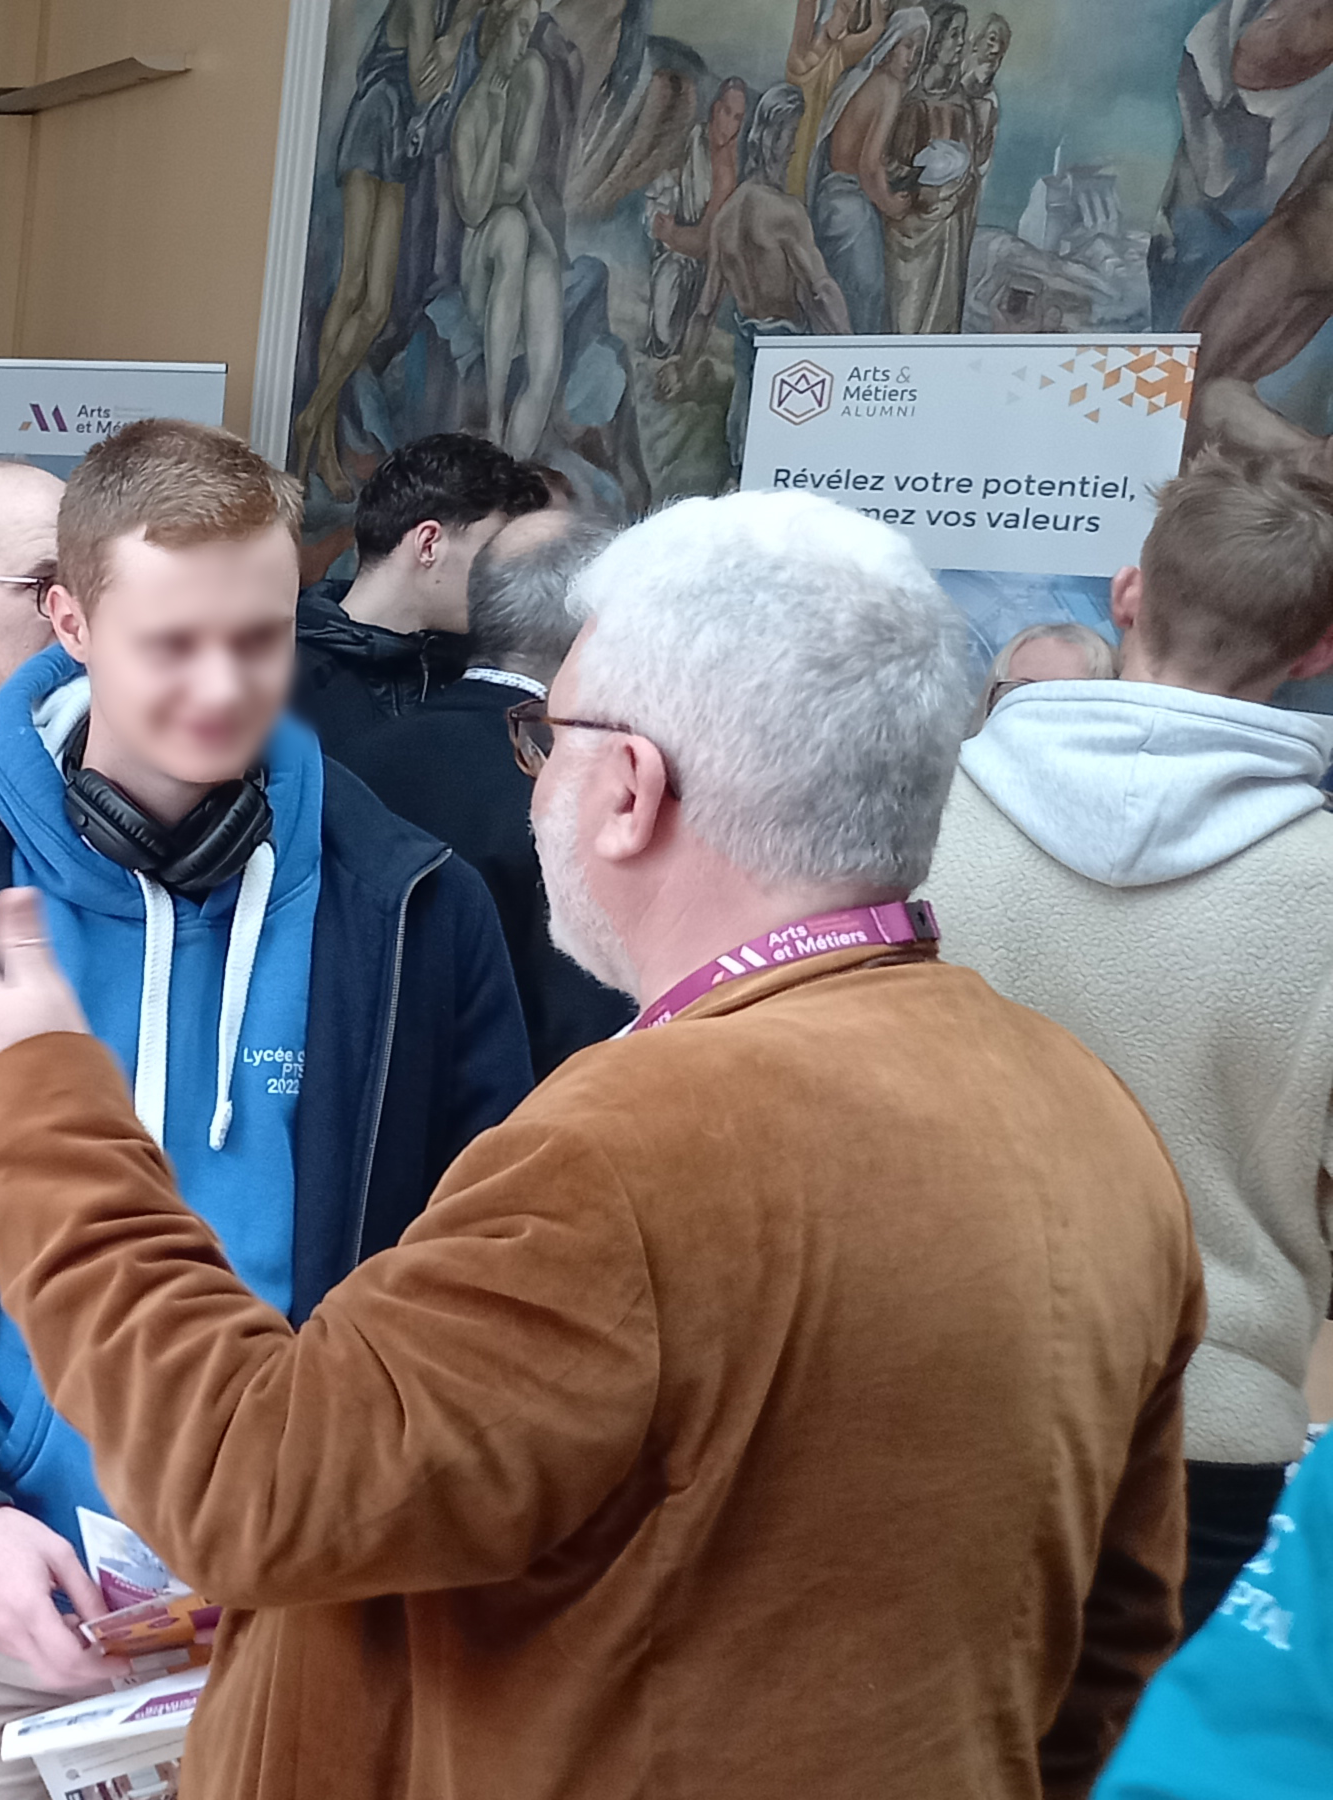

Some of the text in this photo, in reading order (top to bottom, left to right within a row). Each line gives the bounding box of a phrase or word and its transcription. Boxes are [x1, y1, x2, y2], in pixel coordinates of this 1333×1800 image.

[847, 366, 911, 384] Arts &
[842, 382, 918, 402] Métiers
[77, 404, 111, 419] Arts
[841, 405, 916, 418] ALUMNI
[75, 421, 92, 434] et
[772, 468, 1136, 502] Révélez votre potentiel,
[926, 510, 977, 529] vos
[987, 506, 1101, 533] valeurs
[768, 923, 808, 948] Arts
[773, 928, 868, 961] et Métiers
[244, 1046, 293, 1066] Lycée
